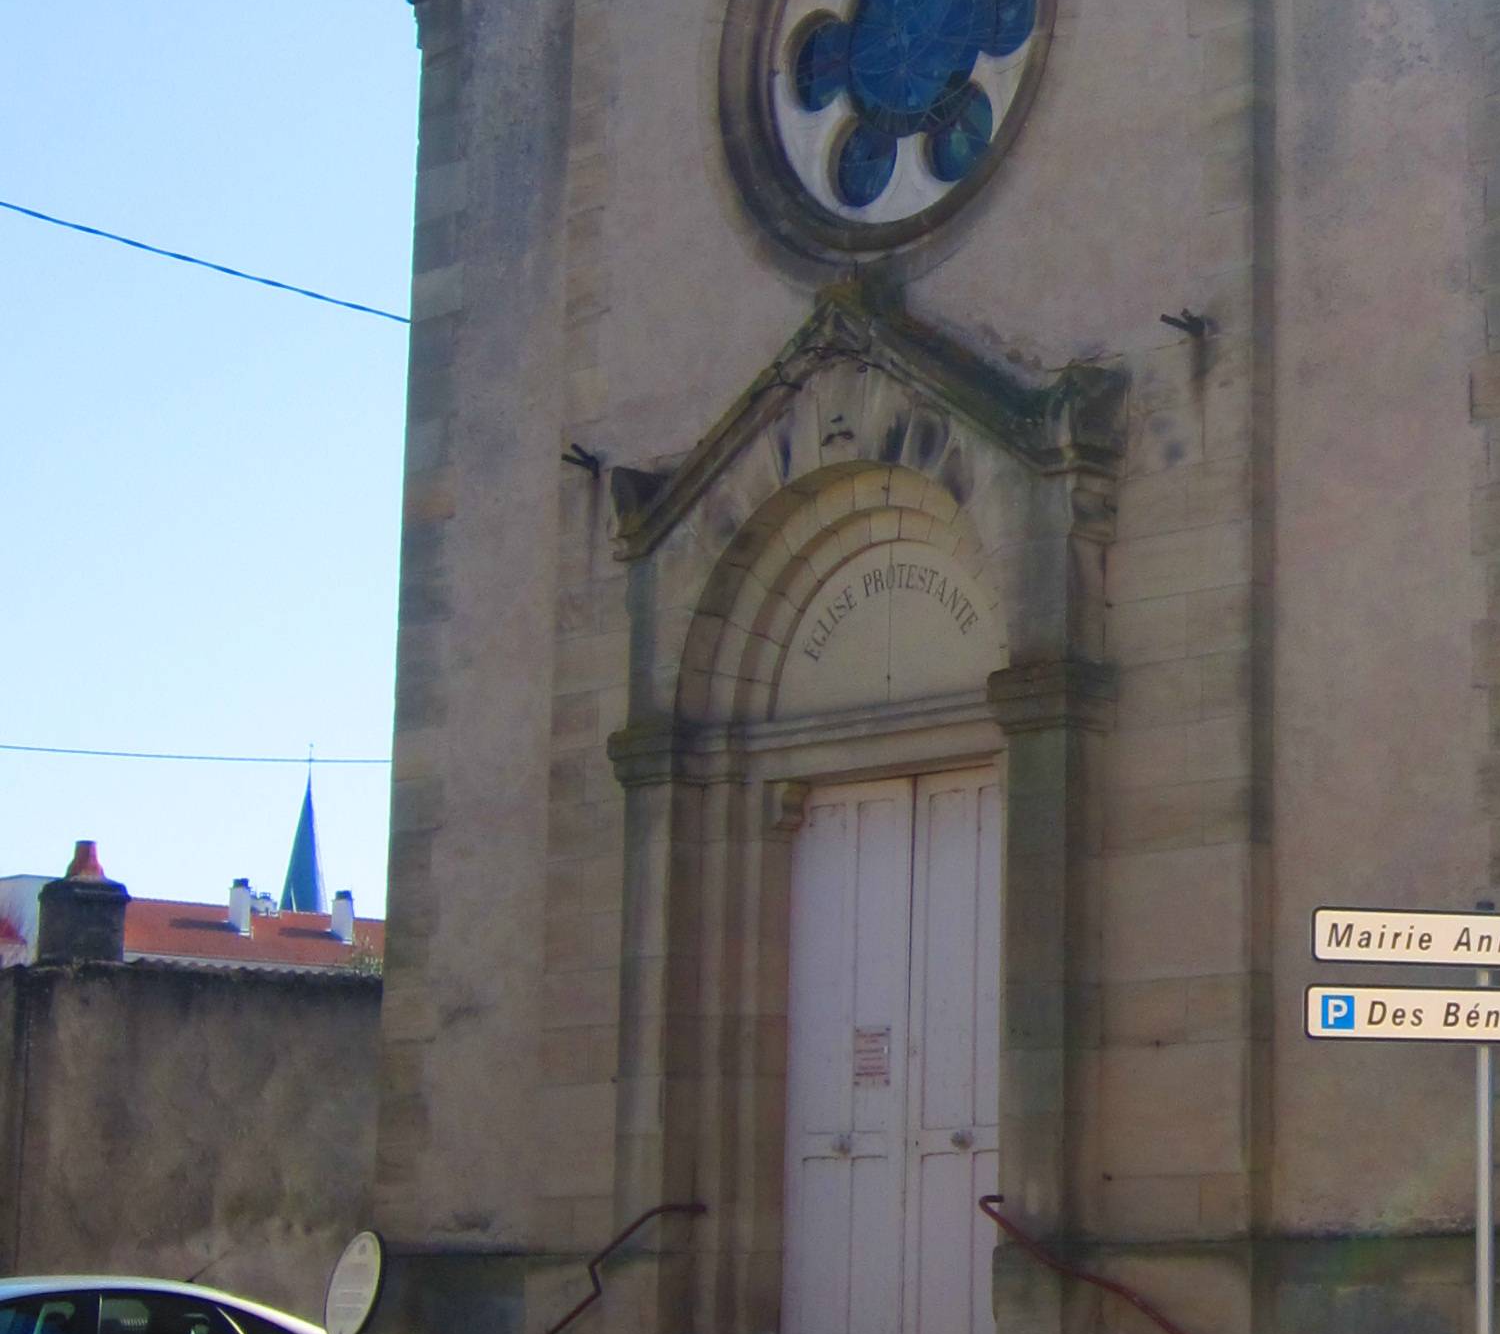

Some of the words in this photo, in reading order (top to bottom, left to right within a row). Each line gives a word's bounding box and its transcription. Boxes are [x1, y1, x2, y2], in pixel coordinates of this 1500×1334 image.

[863, 563, 979, 635] PROTESTANTE
[1327, 922, 1434, 951] Mairie
[1327, 998, 1349, 1026] P
[1366, 999, 1425, 1028] Des
